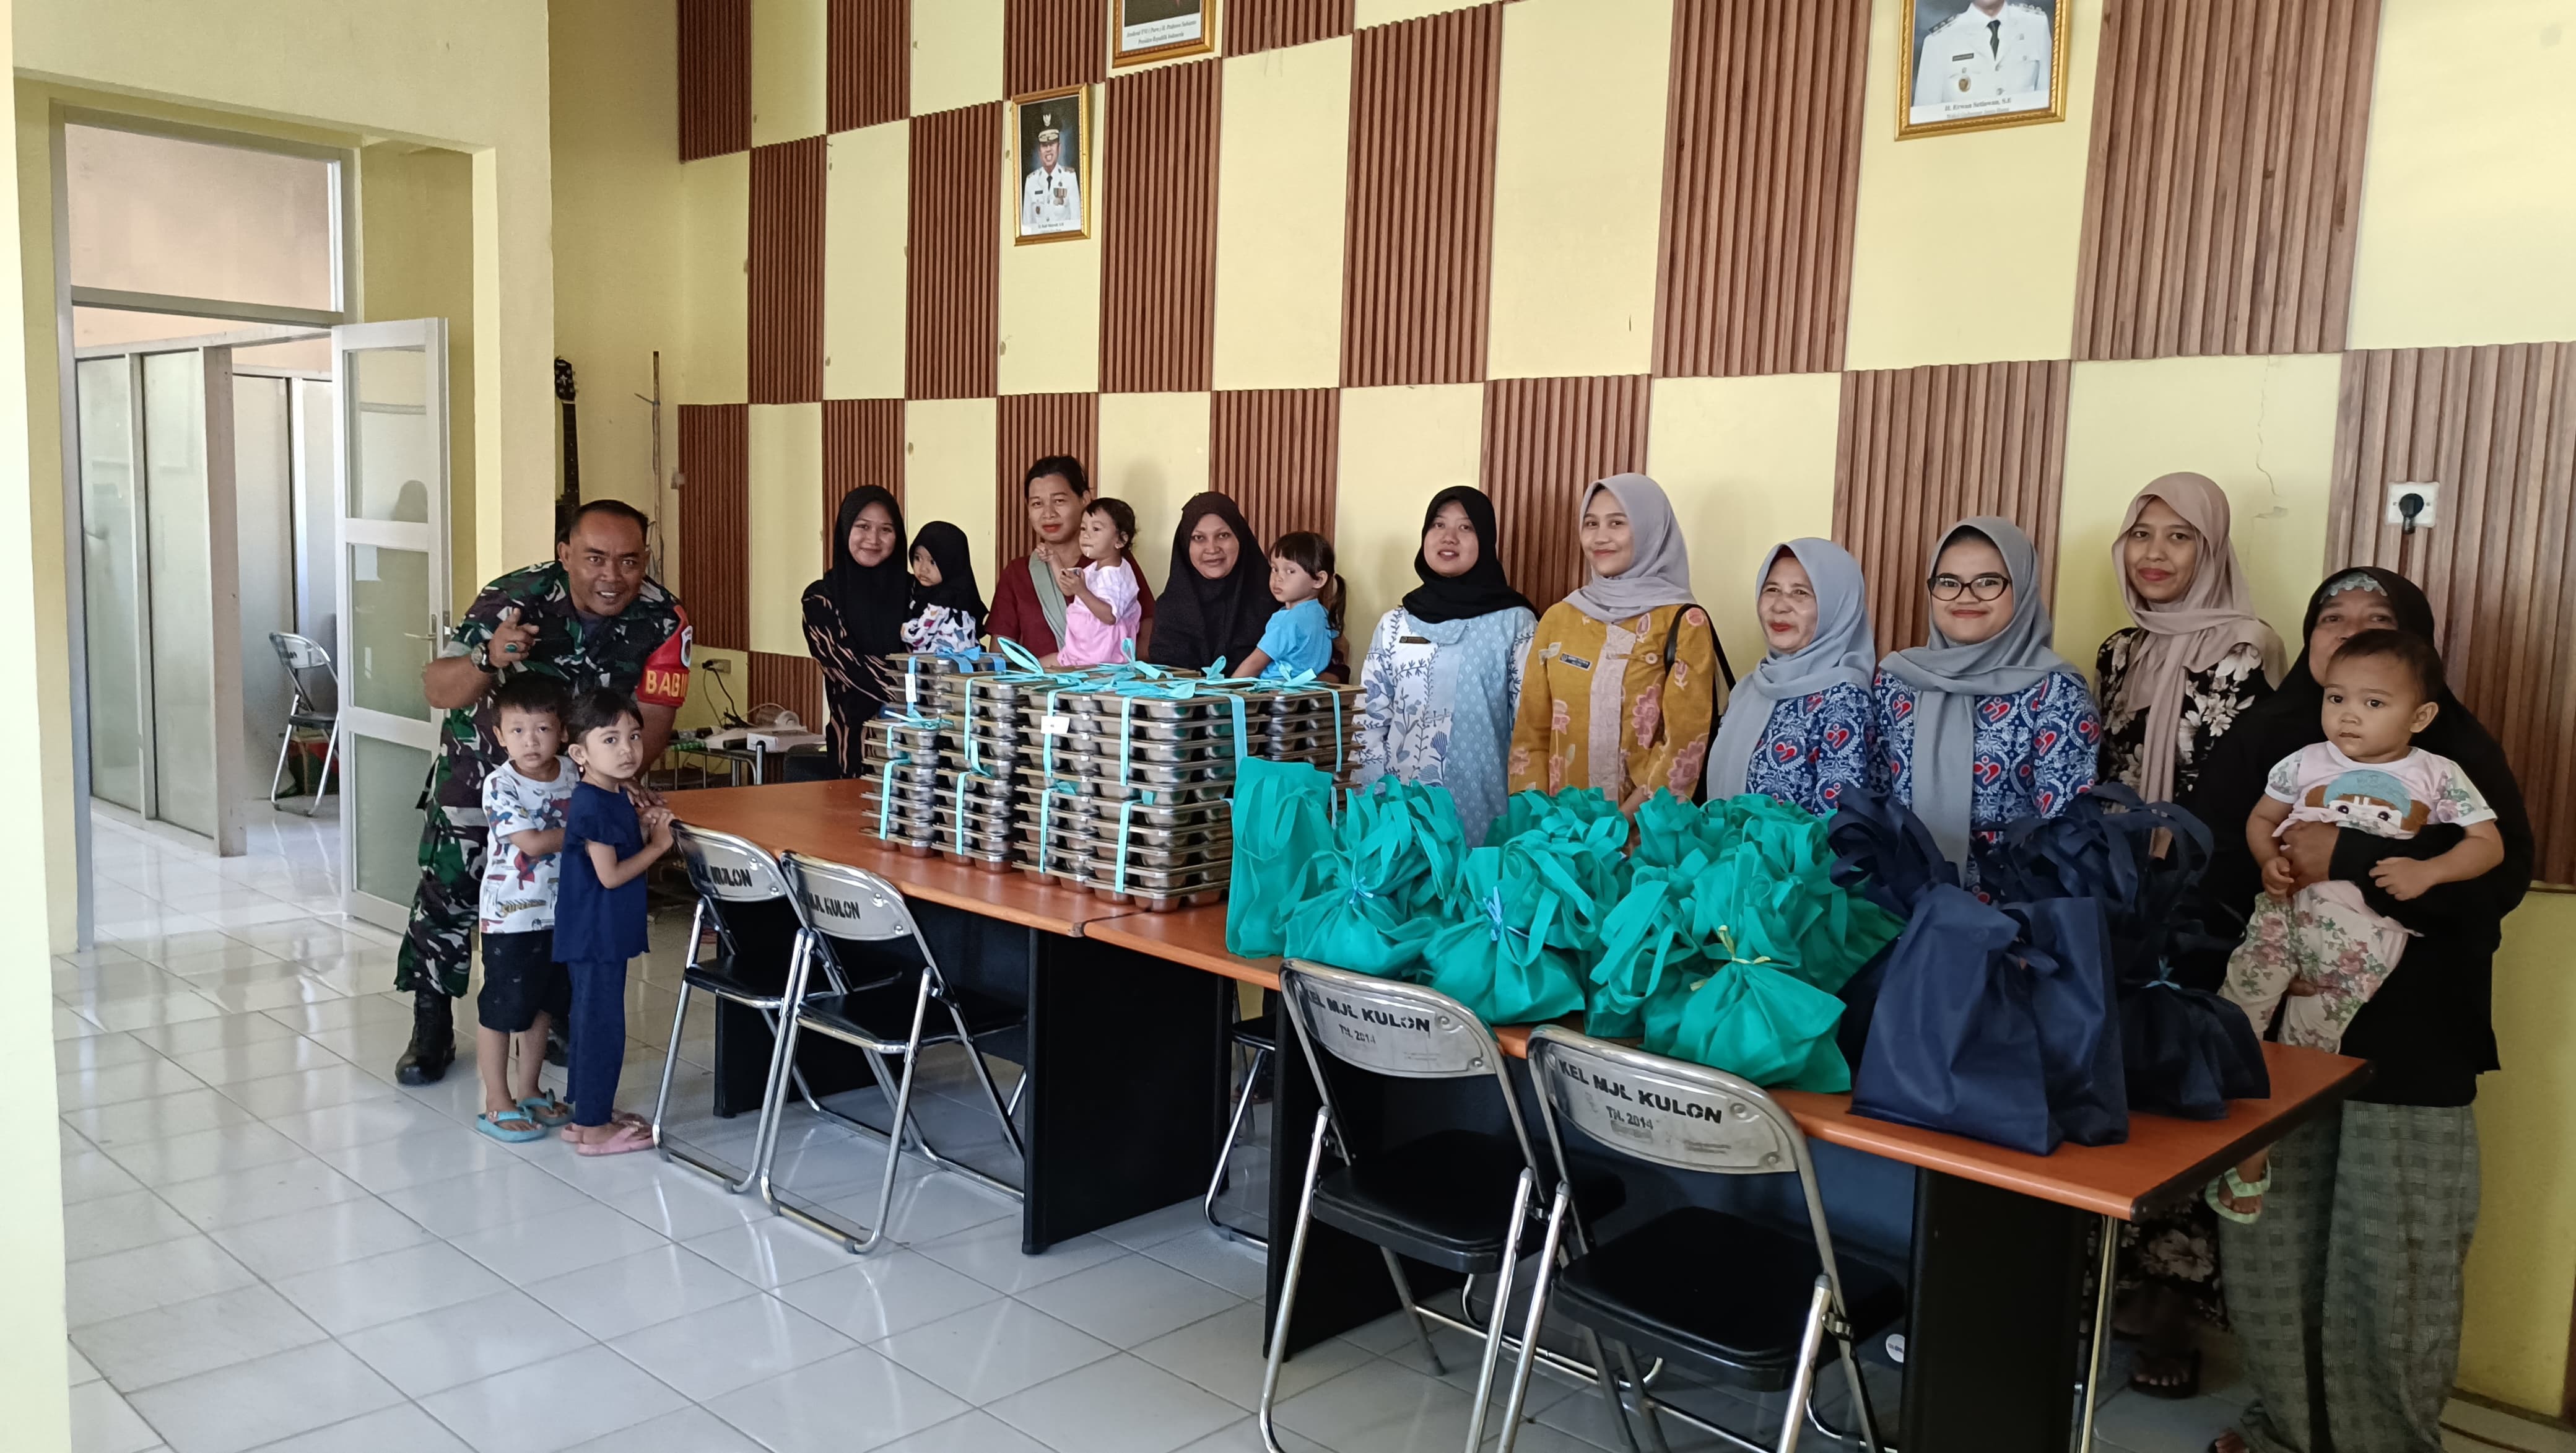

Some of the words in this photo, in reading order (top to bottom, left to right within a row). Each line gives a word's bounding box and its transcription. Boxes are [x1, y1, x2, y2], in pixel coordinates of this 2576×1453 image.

[824, 896, 860, 919] KULON
[1307, 989, 1326, 1009] KEL
[1326, 997, 1358, 1019] MJL
[1362, 1008, 1430, 1032] KULON
[1558, 1059, 1590, 1085] KEL
[1592, 1074, 1633, 1101] MJL
[1638, 1089, 1722, 1124] KULON
[1627, 1112, 1654, 1130] 2014
